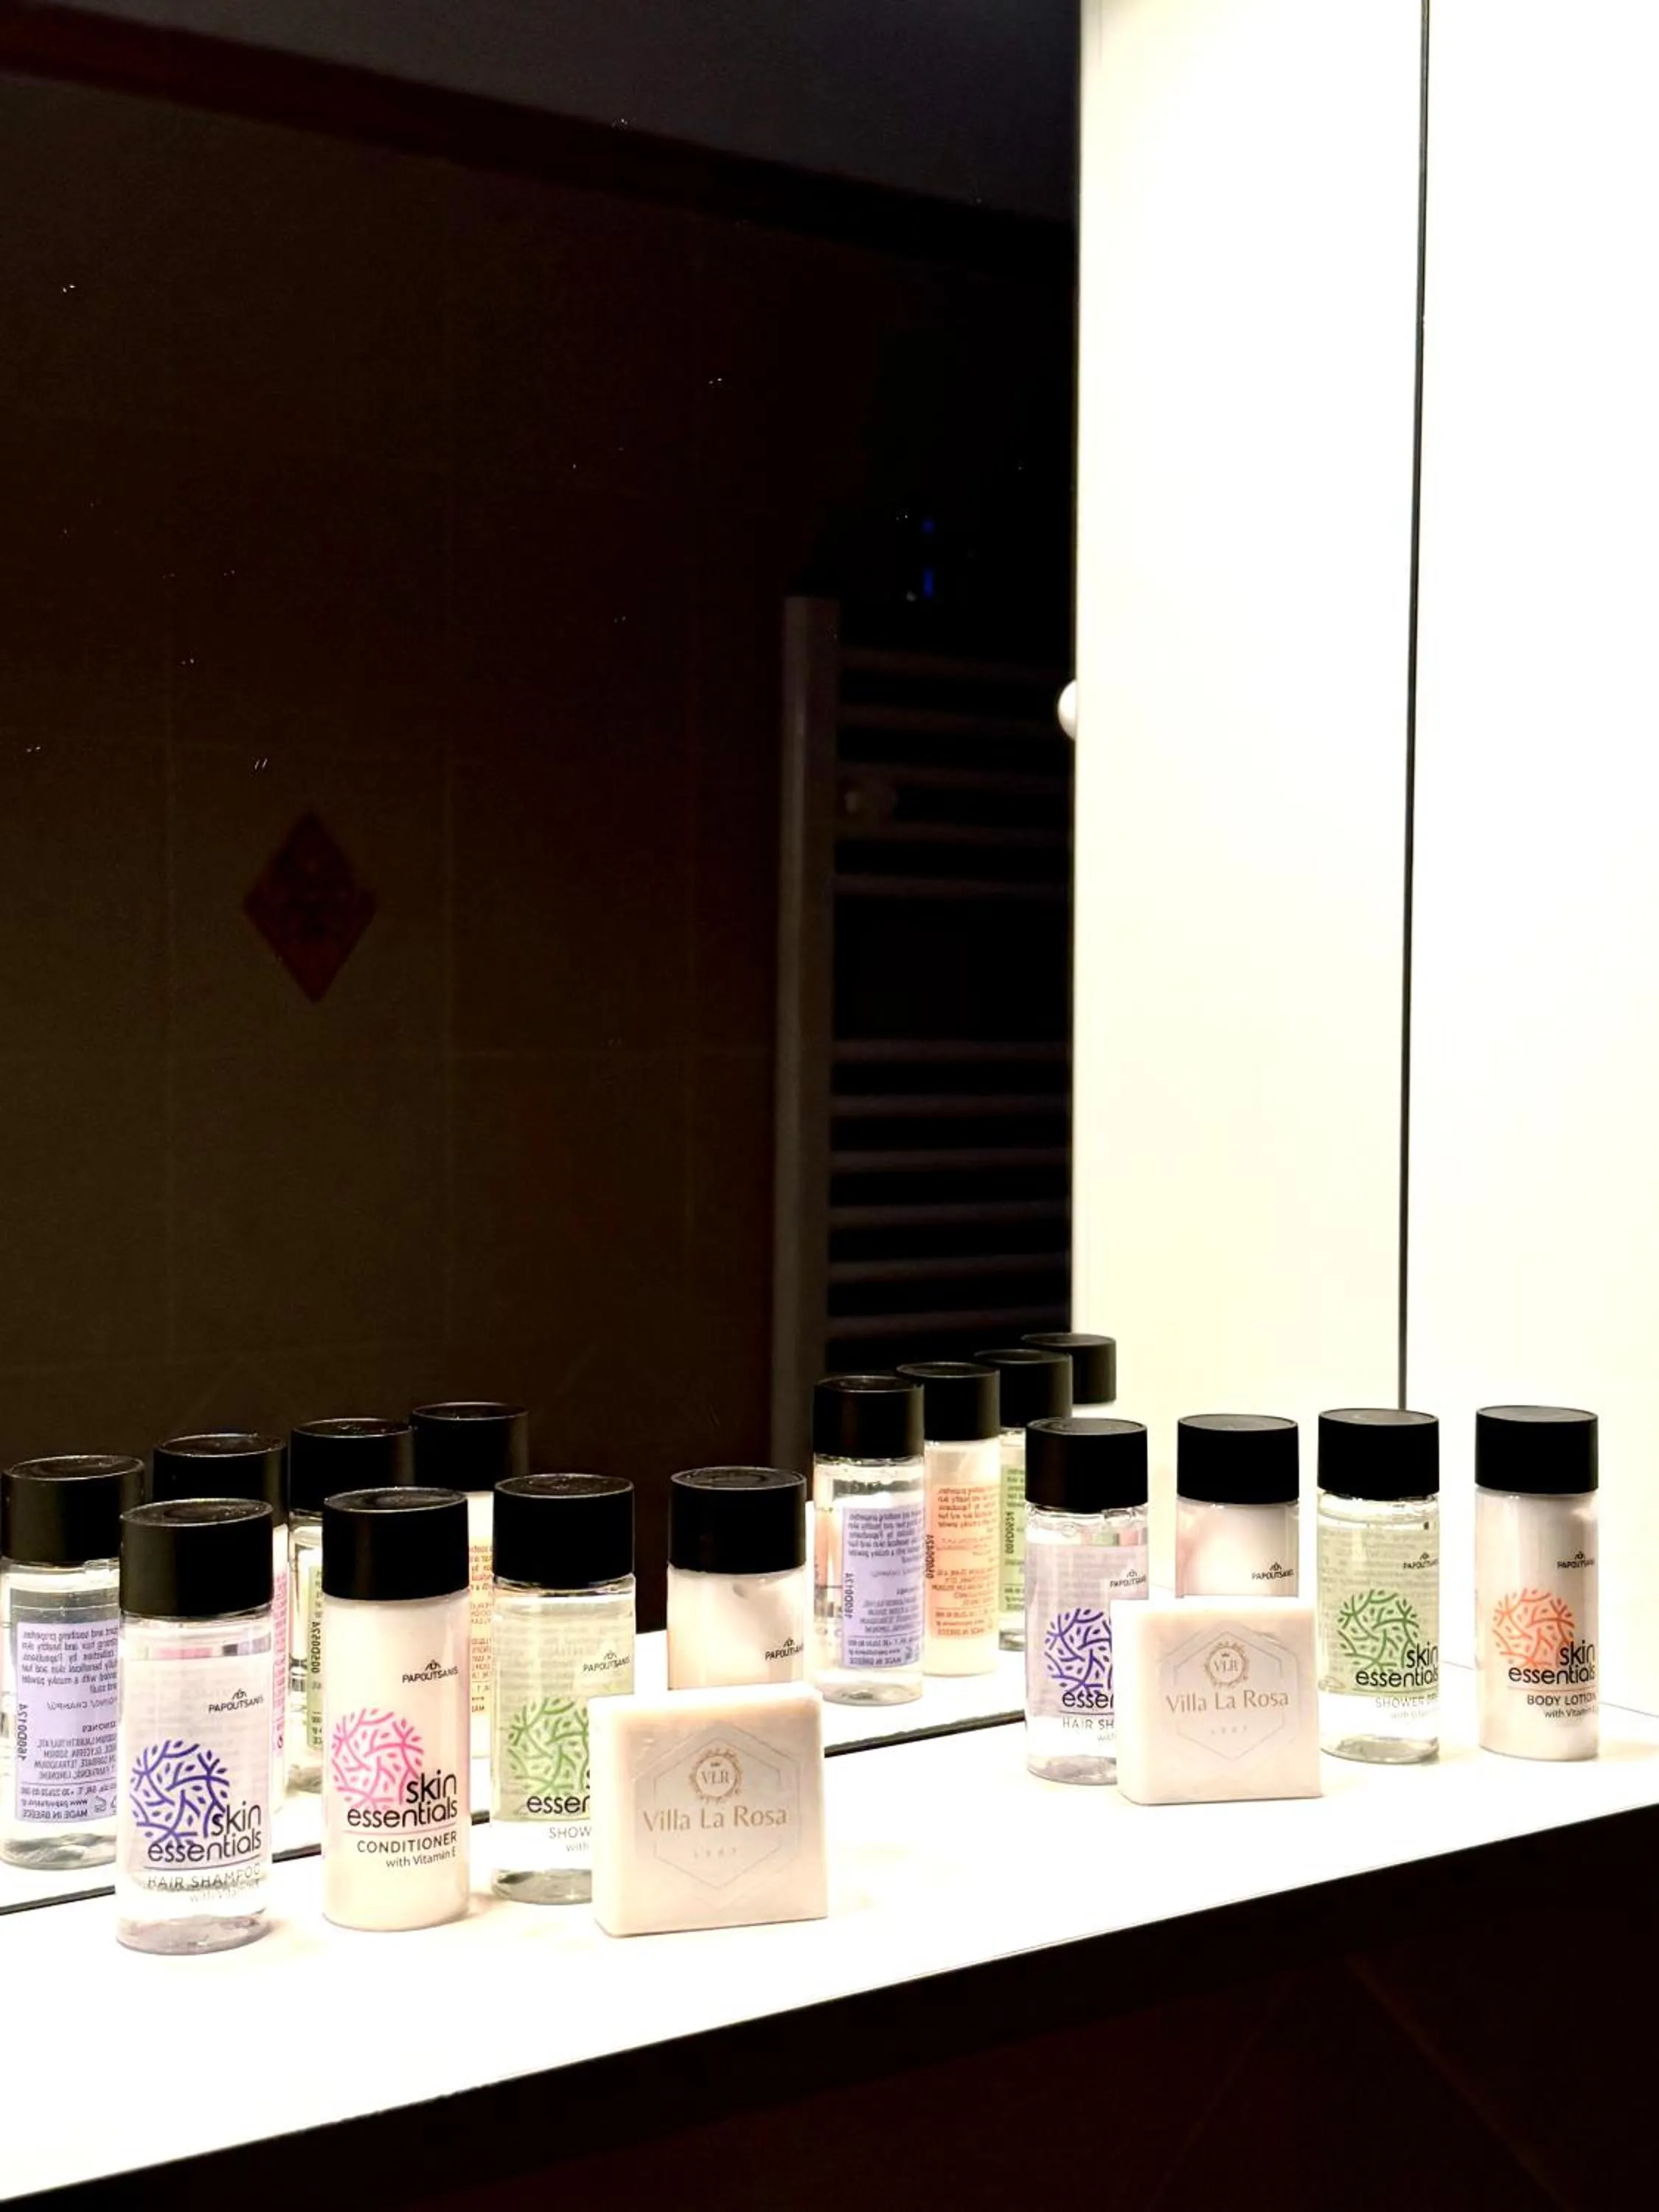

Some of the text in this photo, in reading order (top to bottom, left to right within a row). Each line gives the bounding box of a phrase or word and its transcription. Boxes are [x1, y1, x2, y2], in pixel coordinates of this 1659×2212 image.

[1406, 1641, 1439, 1669] skin
[1559, 1640, 1596, 1666] skin
[402, 1666, 459, 1683] PAPOUTSANIS
[1166, 1689, 1289, 1714] Villa La Rosa
[1527, 1694, 1560, 1705] BODY
[1062, 1717, 1093, 1729] HAIR
[406, 1769, 457, 1805] skin
[702, 1770, 729, 1784] VLR
[347, 1797, 458, 1829] essentials
[526, 1794, 591, 1814] essen
[211, 1801, 261, 1837] skin
[642, 1804, 787, 1832] Villa La Rosa
[357, 1830, 457, 1854] CONDITIONER
[549, 1825, 591, 1840] SHOW
[147, 1828, 261, 1863] essentials
[386, 1845, 457, 1868] with Vitamin E
[147, 1874, 184, 1890] HAIR
